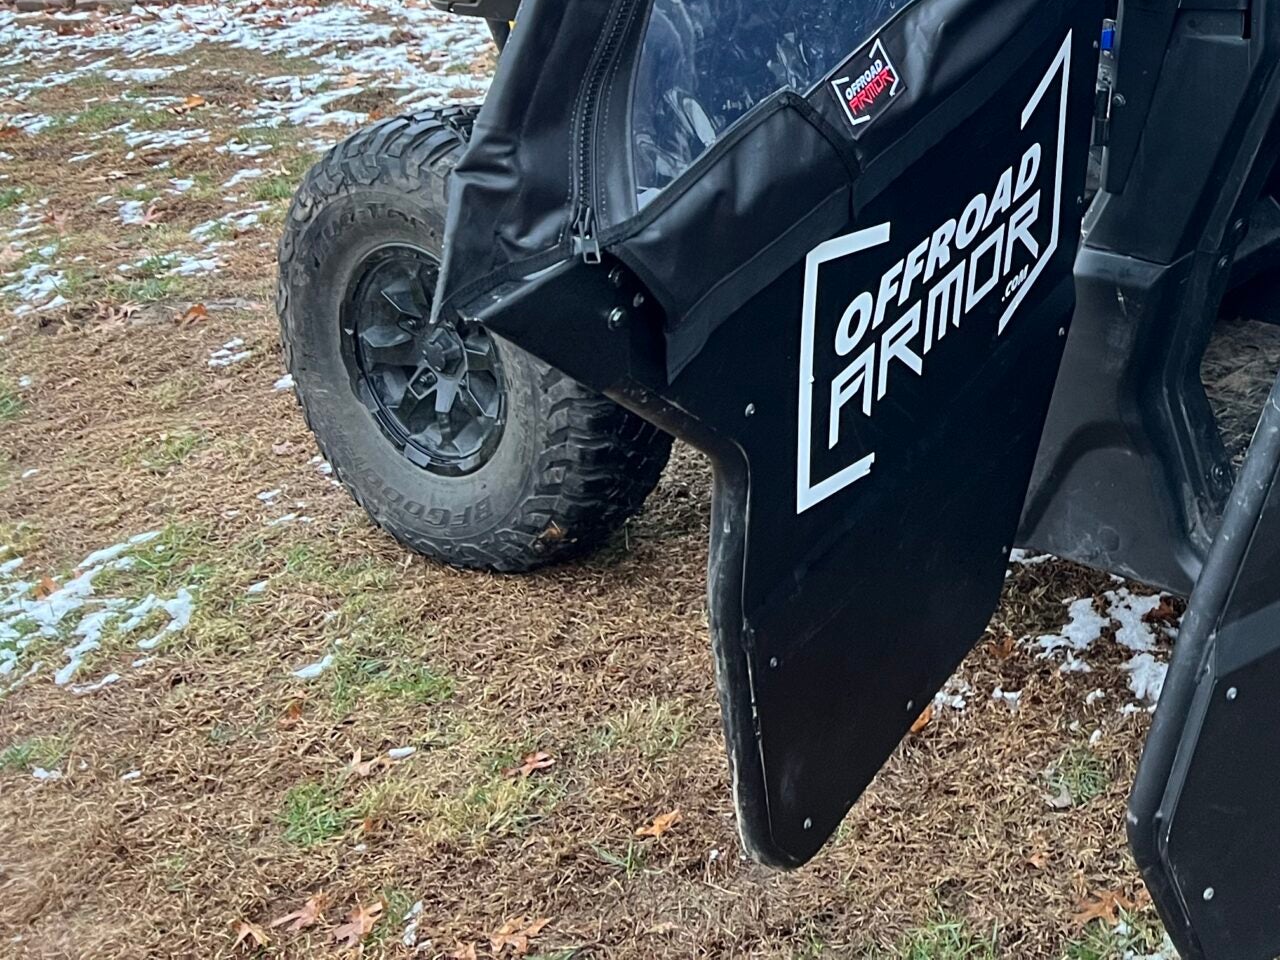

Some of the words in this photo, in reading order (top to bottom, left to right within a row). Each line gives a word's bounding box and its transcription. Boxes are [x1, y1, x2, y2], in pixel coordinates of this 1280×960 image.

[845, 59, 883, 100] OFFROAD
[849, 67, 895, 115] ARMOR
[834, 142, 1042, 356] OFFROAD
[828, 189, 1041, 450] ARMOR
